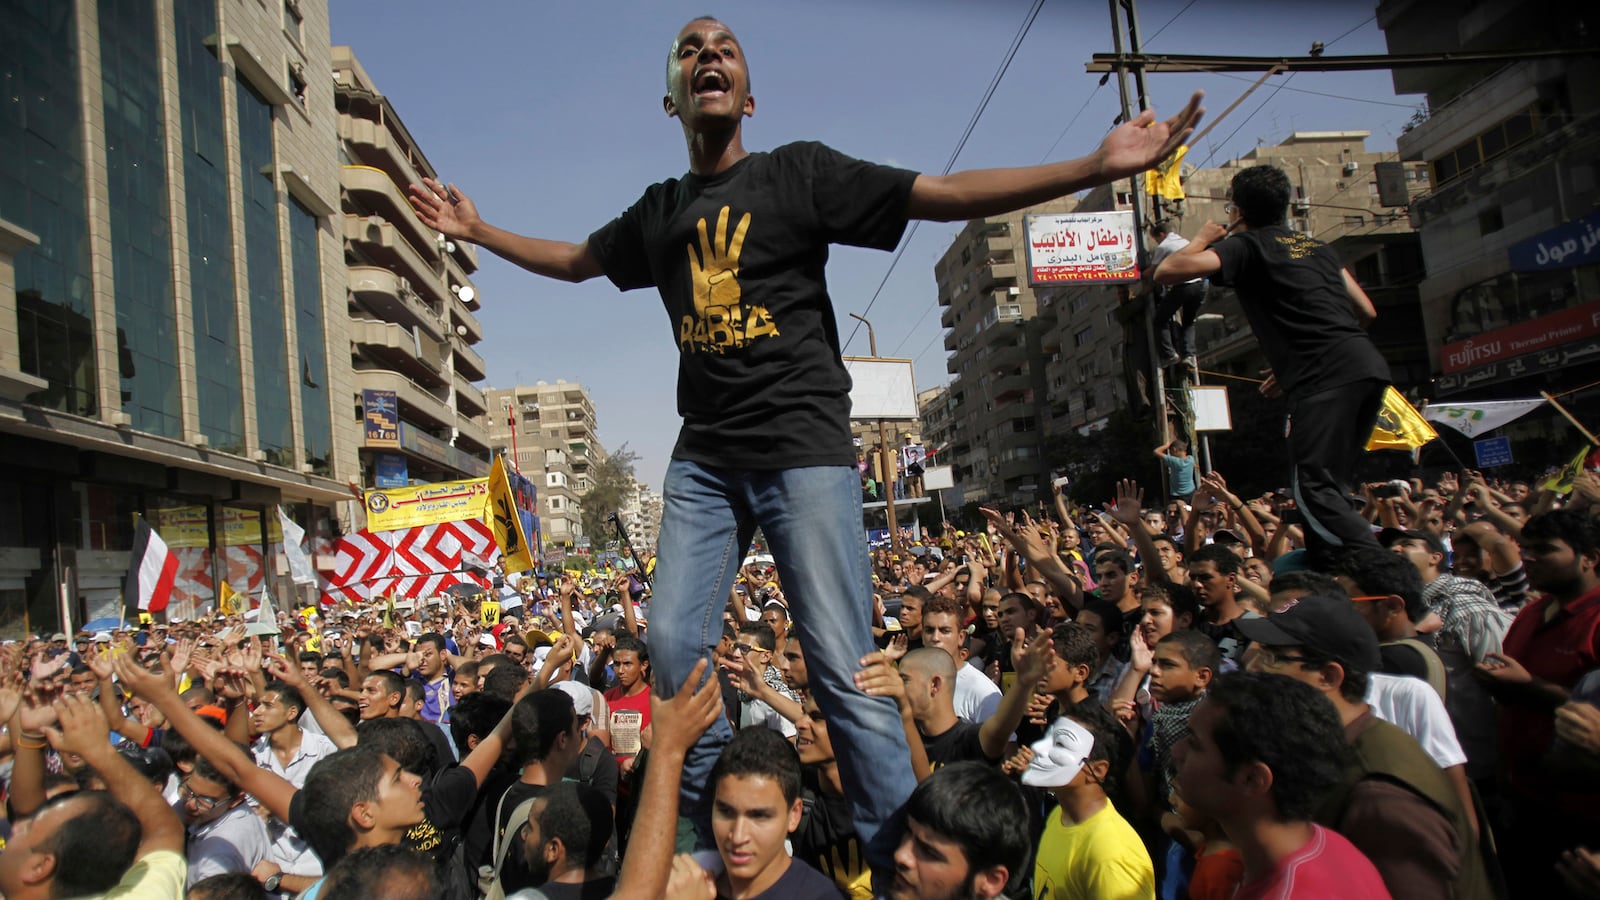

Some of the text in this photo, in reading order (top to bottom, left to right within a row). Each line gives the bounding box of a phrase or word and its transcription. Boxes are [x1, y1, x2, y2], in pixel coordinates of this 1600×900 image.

[1535, 238, 1578, 265] مول
[1449, 323, 1585, 367] FUJITSU Thermal Printer
[367, 429, 397, 440] 16769
